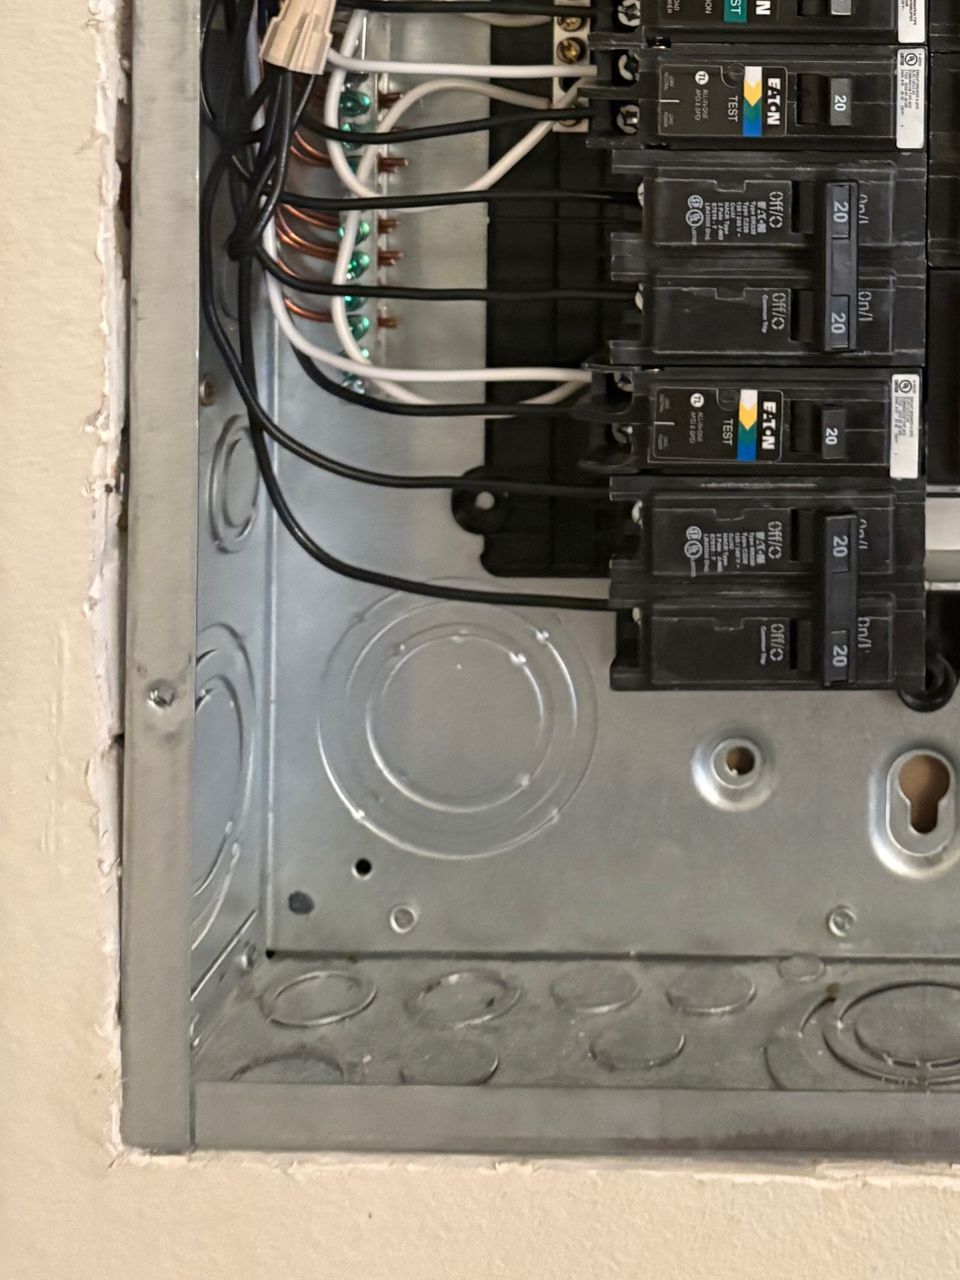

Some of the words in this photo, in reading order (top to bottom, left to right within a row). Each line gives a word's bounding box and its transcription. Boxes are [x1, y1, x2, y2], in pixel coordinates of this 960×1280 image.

[728, 95, 738, 122] TEST
[767, 78, 780, 125] EATON
[834, 95, 847, 111] 20
[833, 201, 849, 223] 20
[831, 312, 846, 334] 20
[722, 418, 734, 446] TEST
[762, 401, 776, 450] EATON
[825, 427, 838, 445] 20
[833, 535, 848, 558] 20
[833, 645, 848, 667] 20
